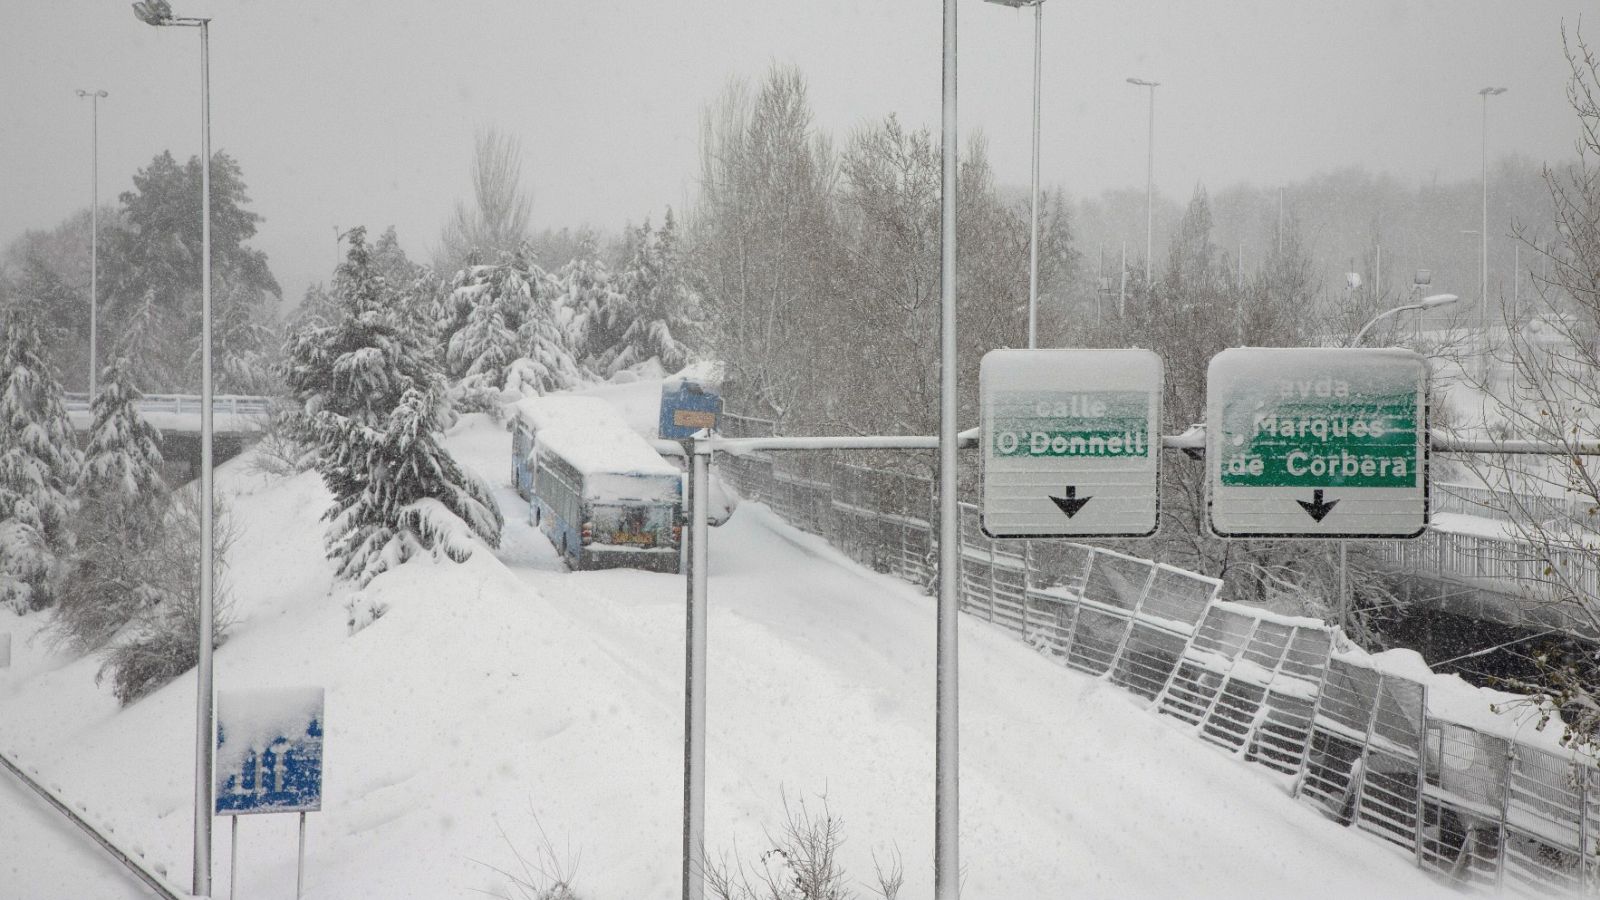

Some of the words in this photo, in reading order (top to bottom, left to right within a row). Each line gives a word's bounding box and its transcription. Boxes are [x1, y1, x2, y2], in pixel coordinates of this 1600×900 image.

[1037, 394, 1107, 417] calle
[997, 431, 1144, 454] O'Donnell
[1229, 453, 1264, 476] de
[1286, 449, 1407, 477] Corbera
